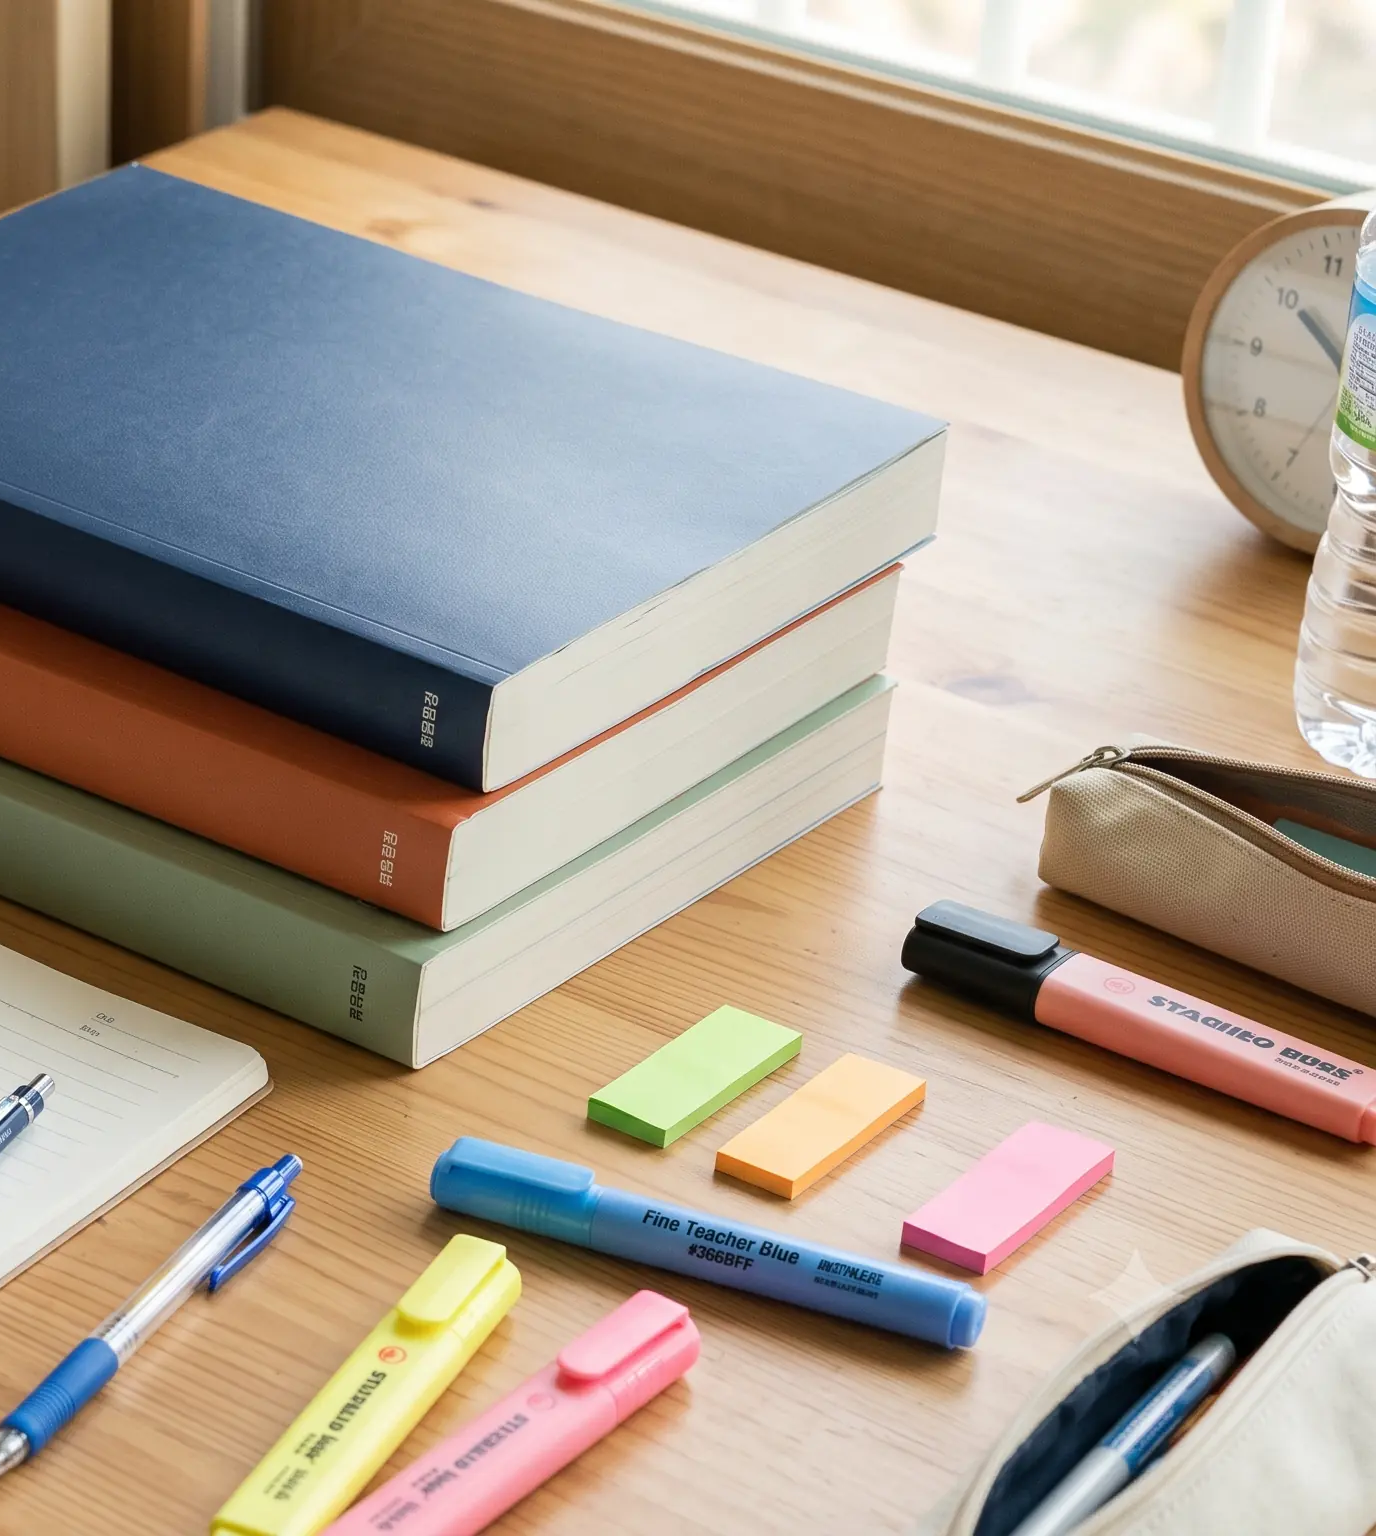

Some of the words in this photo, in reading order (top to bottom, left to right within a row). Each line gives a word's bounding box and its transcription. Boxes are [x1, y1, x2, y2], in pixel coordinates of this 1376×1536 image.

[1323, 254, 1344, 278] 11
[1277, 286, 1300, 311] 10
[1249, 336, 1264, 358] 9
[1252, 396, 1267, 419] 8
[1286, 447, 1301, 469] 7
[642, 1208, 681, 1232] Fine
[685, 1219, 757, 1252] Teacher
[758, 1240, 801, 1265] Blue
[687, 1243, 755, 1272] #366BFF
